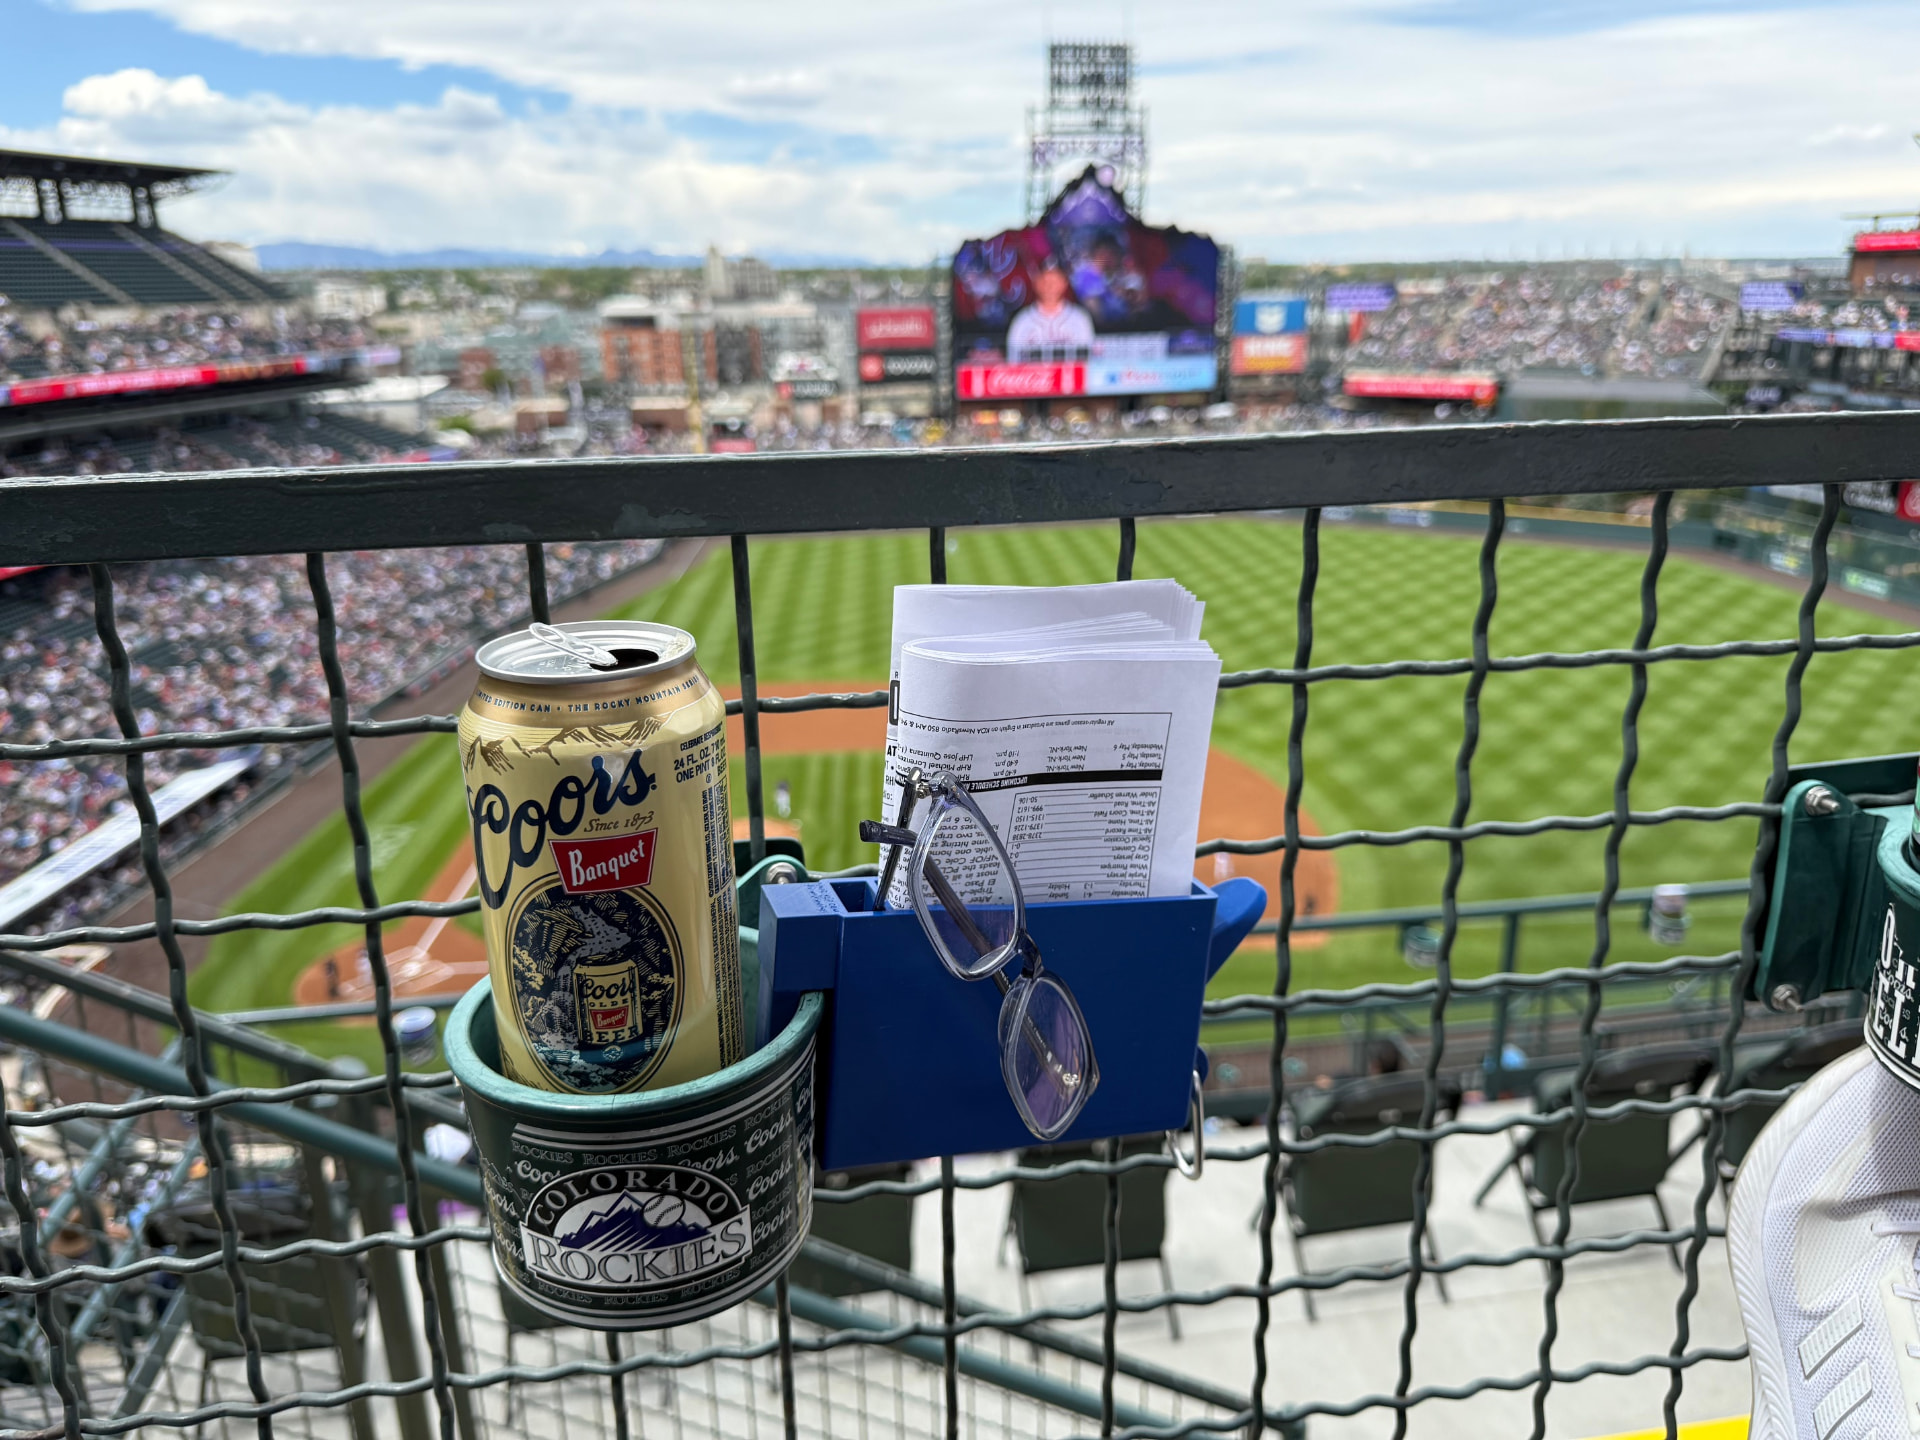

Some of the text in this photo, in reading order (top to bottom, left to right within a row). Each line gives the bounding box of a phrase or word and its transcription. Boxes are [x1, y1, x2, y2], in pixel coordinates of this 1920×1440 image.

[494, 698, 526, 711] EDITION
[530, 703, 552, 713] CAN
[568, 703, 590, 713] THE
[595, 698, 632, 711] ROCKY
[636, 686, 683, 705] MOUNTAIN
[1022, 722, 1045, 730] broadcast
[909, 748, 942, 760] Quintana
[674, 757, 685, 771] 24
[676, 767, 694, 783] ONE
[695, 759, 710, 776] PINT
[928, 762, 956, 771] Michael
[957, 763, 972, 771] RHP
[972, 781, 1000, 790] SCHEDULE
[1000, 776, 1027, 787] UPCOMING
[1015, 814, 1045, 822] 1315-1150
[1017, 805, 1043, 814] 999-1612
[466, 749, 656, 910] Coors
[584, 811, 655, 833] Since 1873
[1014, 823, 1043, 831] 1379-1226
[568, 839, 646, 887] Banquet
[979, 862, 1000, 871] leads
[959, 887, 993, 897] Triple-A
[596, 1010, 626, 1027] Banquet
[744, 1109, 794, 1154] Coors
[512, 1141, 574, 1164] ROCKIES
[583, 1149, 657, 1165] ROCKIES
[667, 1125, 737, 1158] ROCKIES
[746, 1157, 793, 1200] Coors
[533, 1170, 729, 1226] COLORADO
[752, 1202, 793, 1247] Coors
[527, 1217, 747, 1283] ROCKIES
[538, 1269, 741, 1306] ROCKIES ROCKIES ROCKIES
